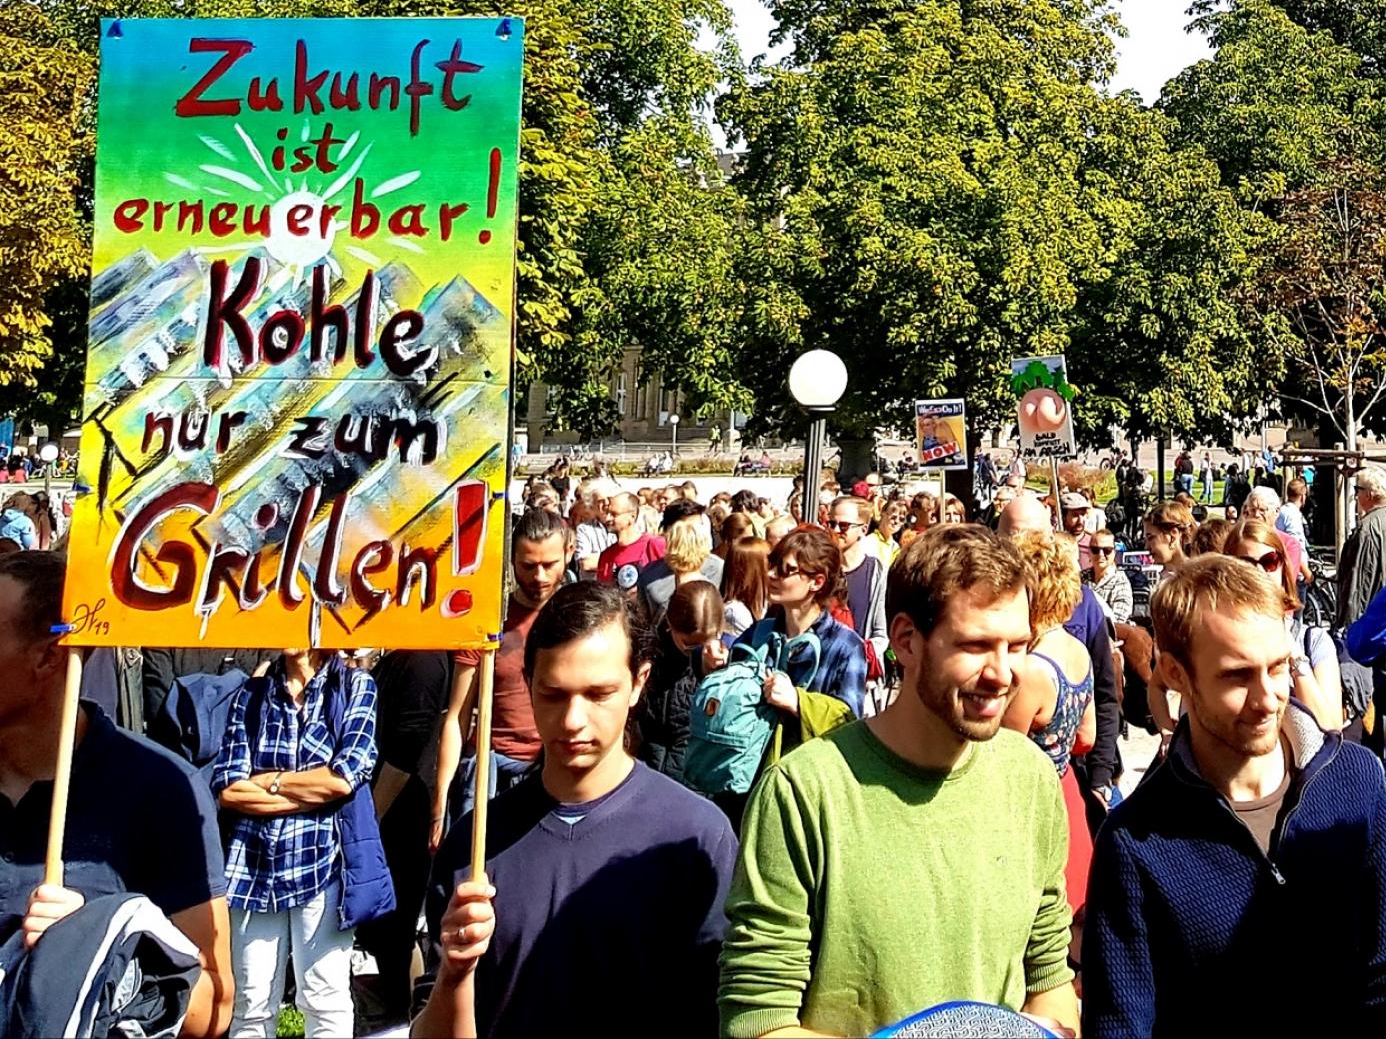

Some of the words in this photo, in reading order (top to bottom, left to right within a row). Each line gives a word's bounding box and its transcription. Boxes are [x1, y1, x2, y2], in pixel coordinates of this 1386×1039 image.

[175, 38, 484, 136] Zukunft
[114, 148, 501, 243] erneuerbar!
[272, 127, 346, 173] ist
[202, 257, 439, 377] Kohle
[141, 406, 246, 461] nur
[288, 416, 446, 463] zum
[923, 442, 956, 461] NOW
[109, 480, 491, 618] Grillen!
